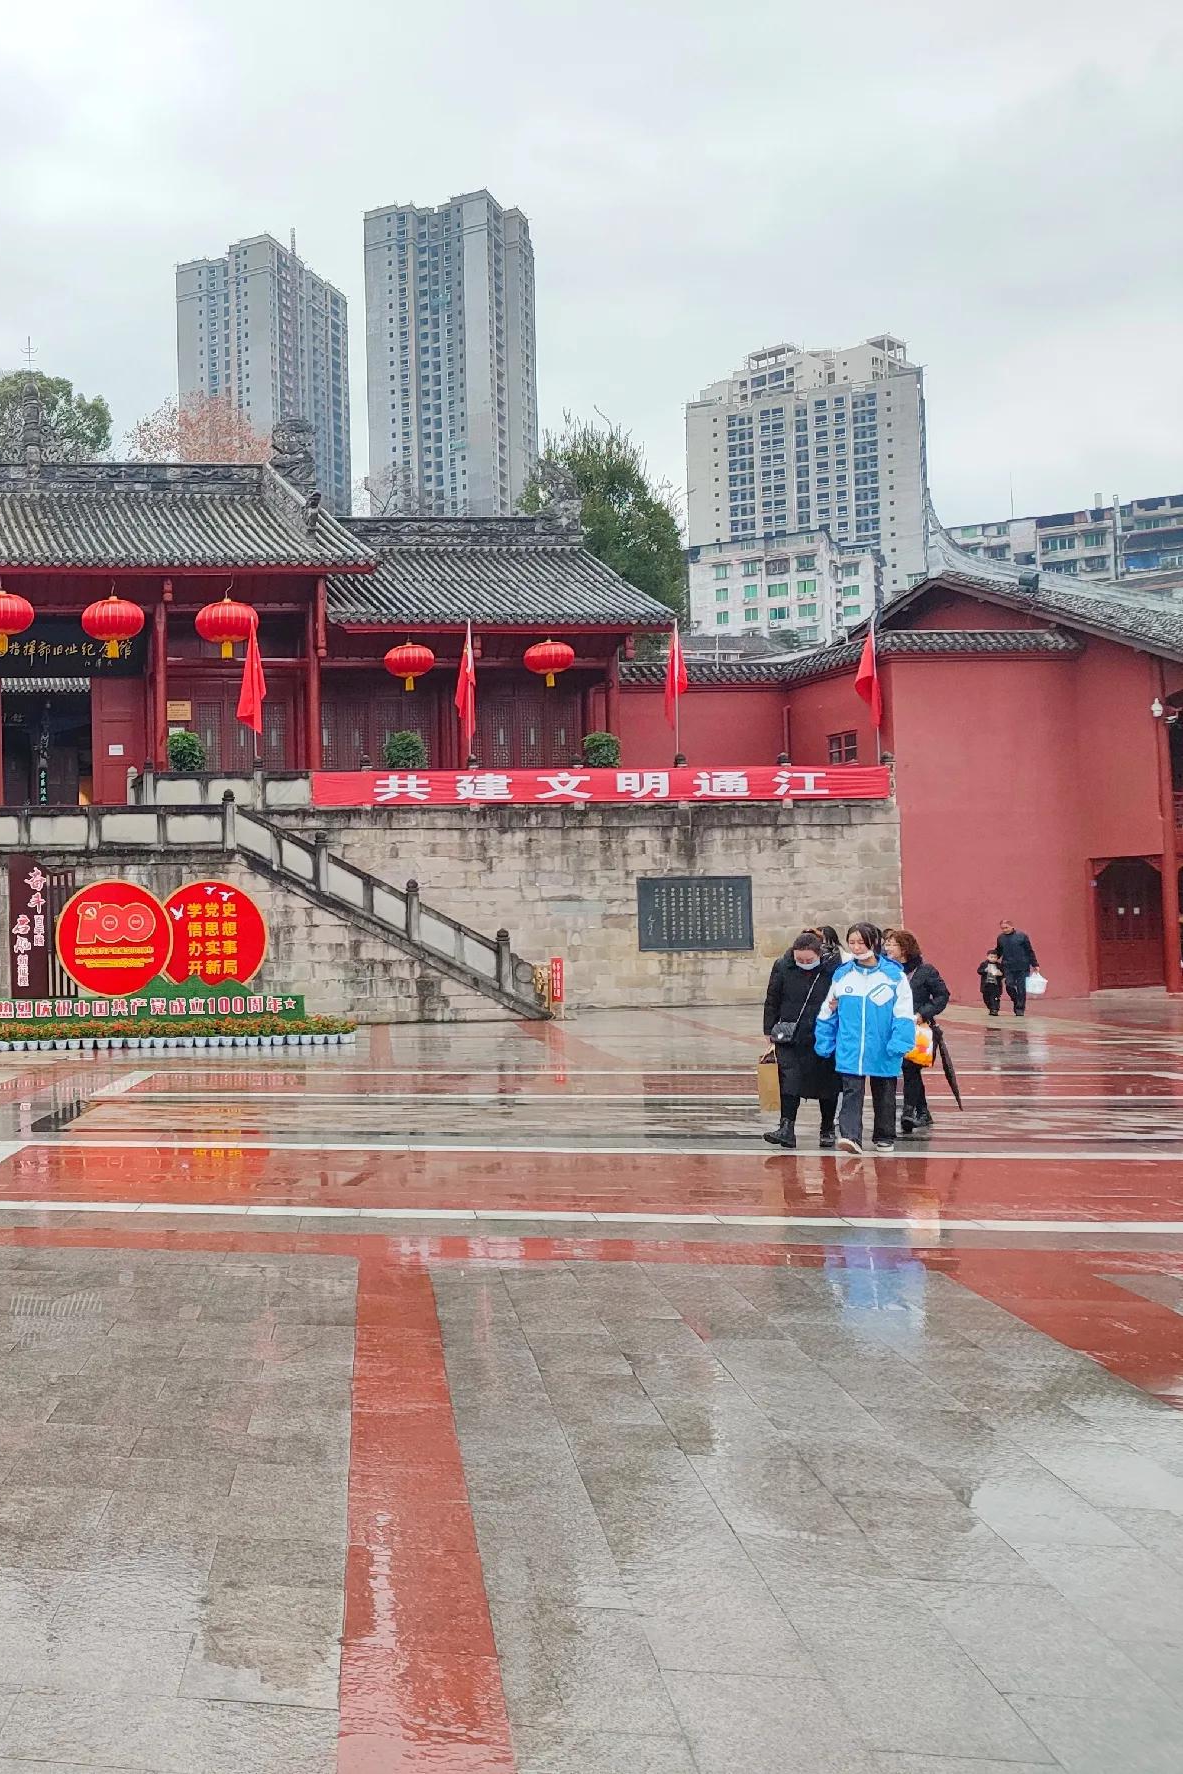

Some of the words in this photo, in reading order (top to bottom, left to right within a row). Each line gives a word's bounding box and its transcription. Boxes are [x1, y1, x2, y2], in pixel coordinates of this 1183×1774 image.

[374, 771, 829, 801] 共建文明通江
[187, 902, 237, 918] 学党史
[76, 902, 156, 944] 100
[188, 921, 237, 937] 悟思想
[188, 940, 237, 956] 办实事
[188, 960, 237, 975] 开新局
